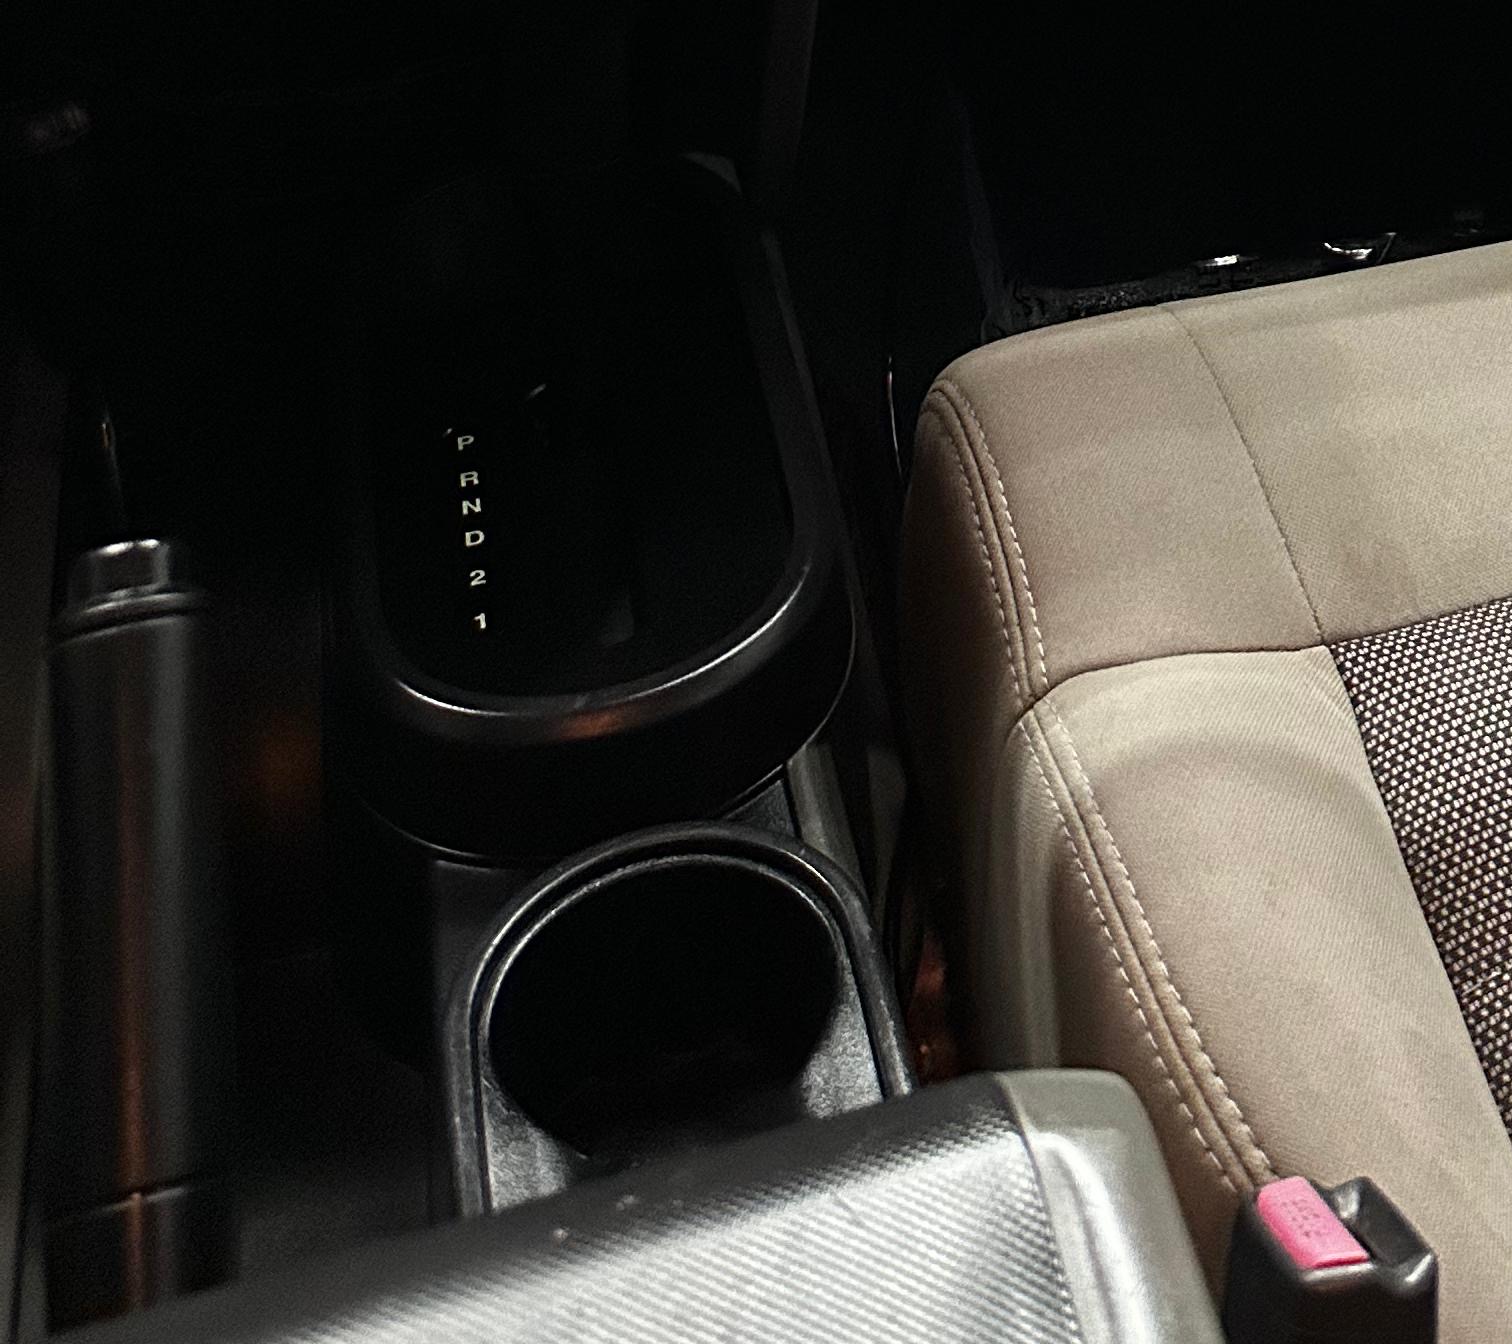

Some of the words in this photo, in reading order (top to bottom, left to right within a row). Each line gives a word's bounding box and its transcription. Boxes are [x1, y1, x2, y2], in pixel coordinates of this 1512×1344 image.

[457, 435, 475, 451] P
[460, 471, 479, 487] R
[462, 498, 482, 515] N
[465, 530, 485, 547] D
[470, 569, 487, 586] 2
[474, 613, 487, 630] 1
